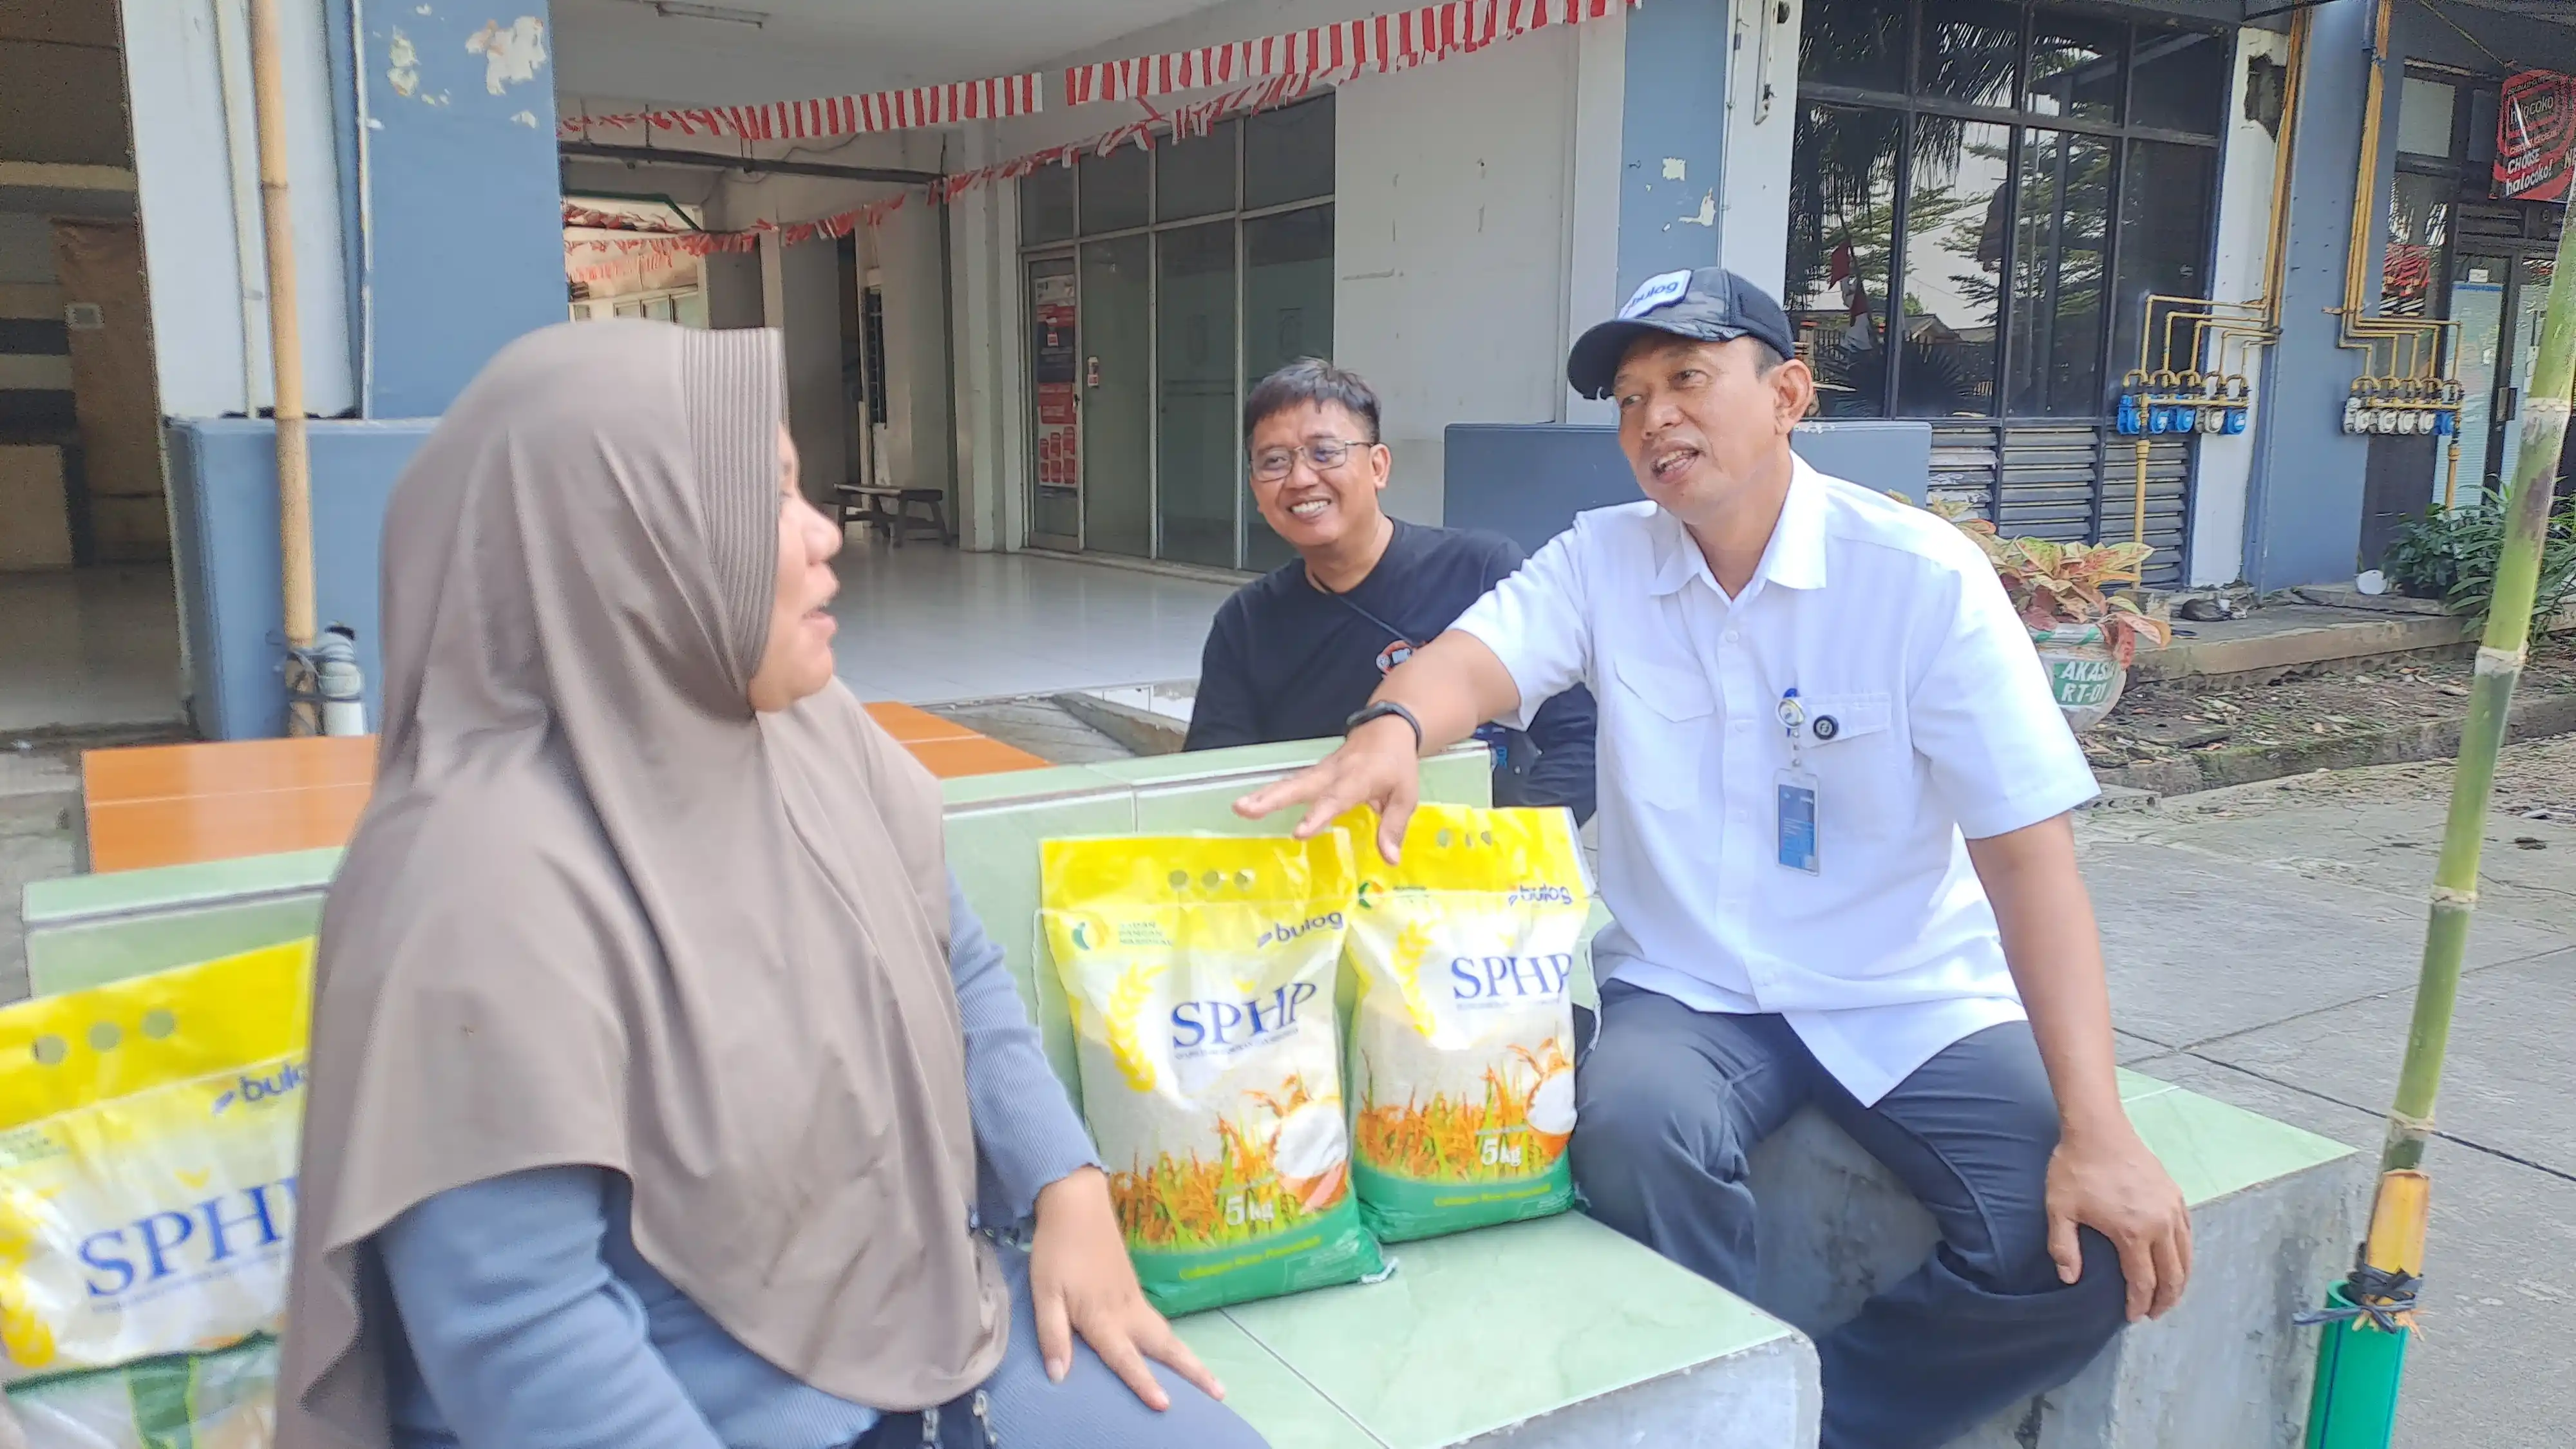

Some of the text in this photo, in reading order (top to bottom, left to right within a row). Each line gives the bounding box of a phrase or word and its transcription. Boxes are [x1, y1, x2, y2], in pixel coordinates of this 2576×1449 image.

[2506, 159, 2553, 196] halocoko!
[2508, 148, 2541, 175] CHOOSE
[1276, 912, 1344, 942] bulog
[1451, 954, 1571, 999] SPHP
[1171, 983, 1316, 1048] SPHP
[1482, 1137, 1499, 1165] 5
[1226, 1195, 1244, 1225] 5
[77, 1178, 298, 1297] SPH
